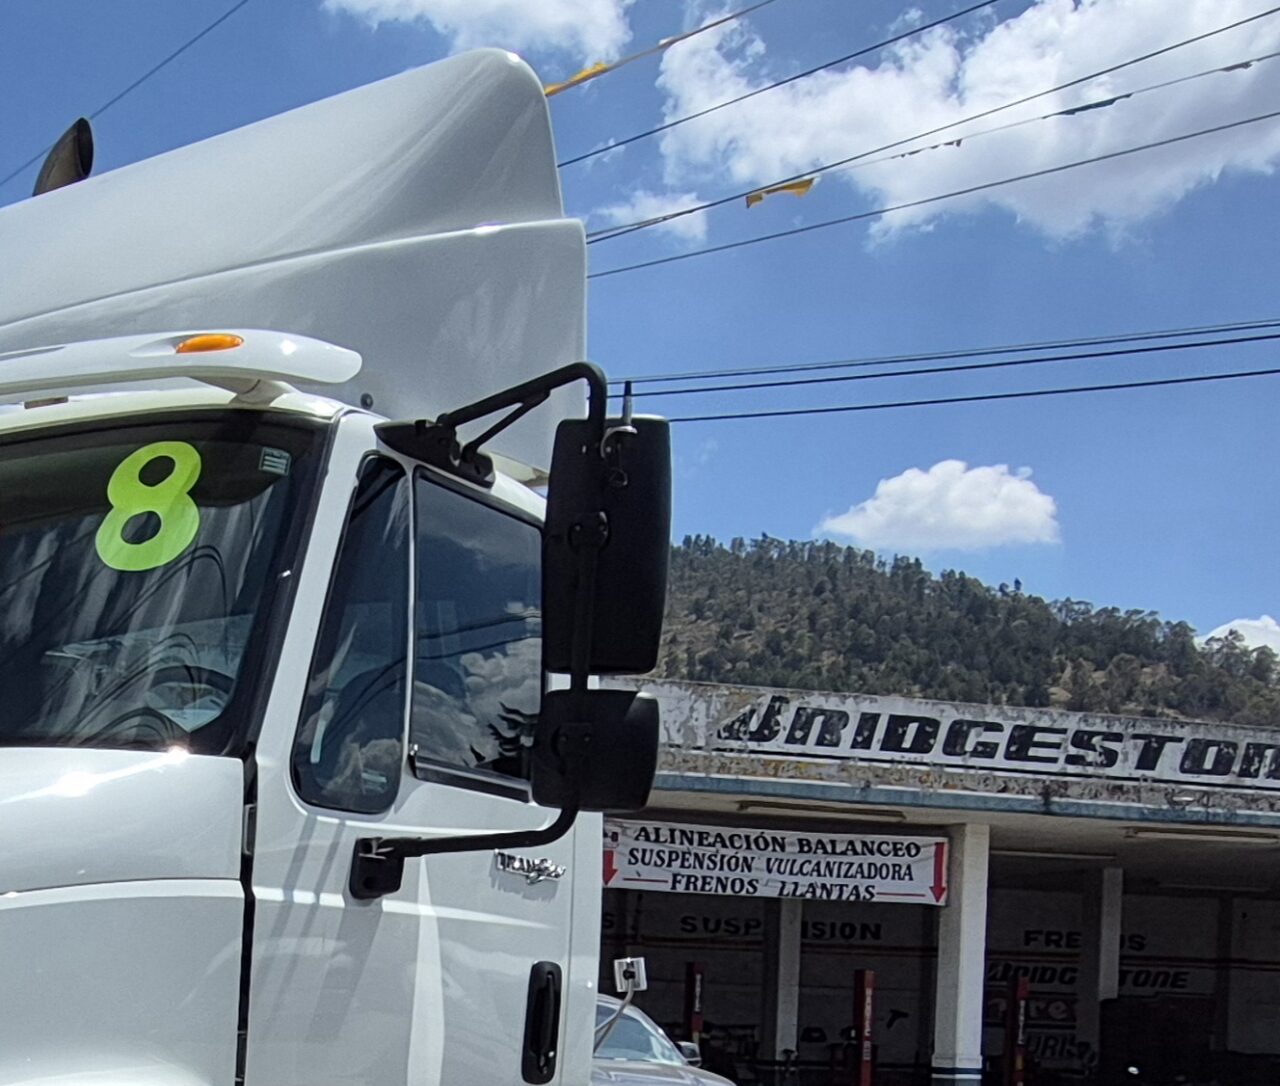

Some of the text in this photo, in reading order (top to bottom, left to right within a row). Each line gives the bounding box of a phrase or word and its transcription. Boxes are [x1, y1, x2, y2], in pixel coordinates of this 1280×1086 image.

[634, 826, 921, 858] ALINEACIÓN BALANCEO
[628, 847, 915, 881] SUSPENSIÓN VULCANIZADORA
[669, 874, 875, 901] FRENOS LLANTAS
